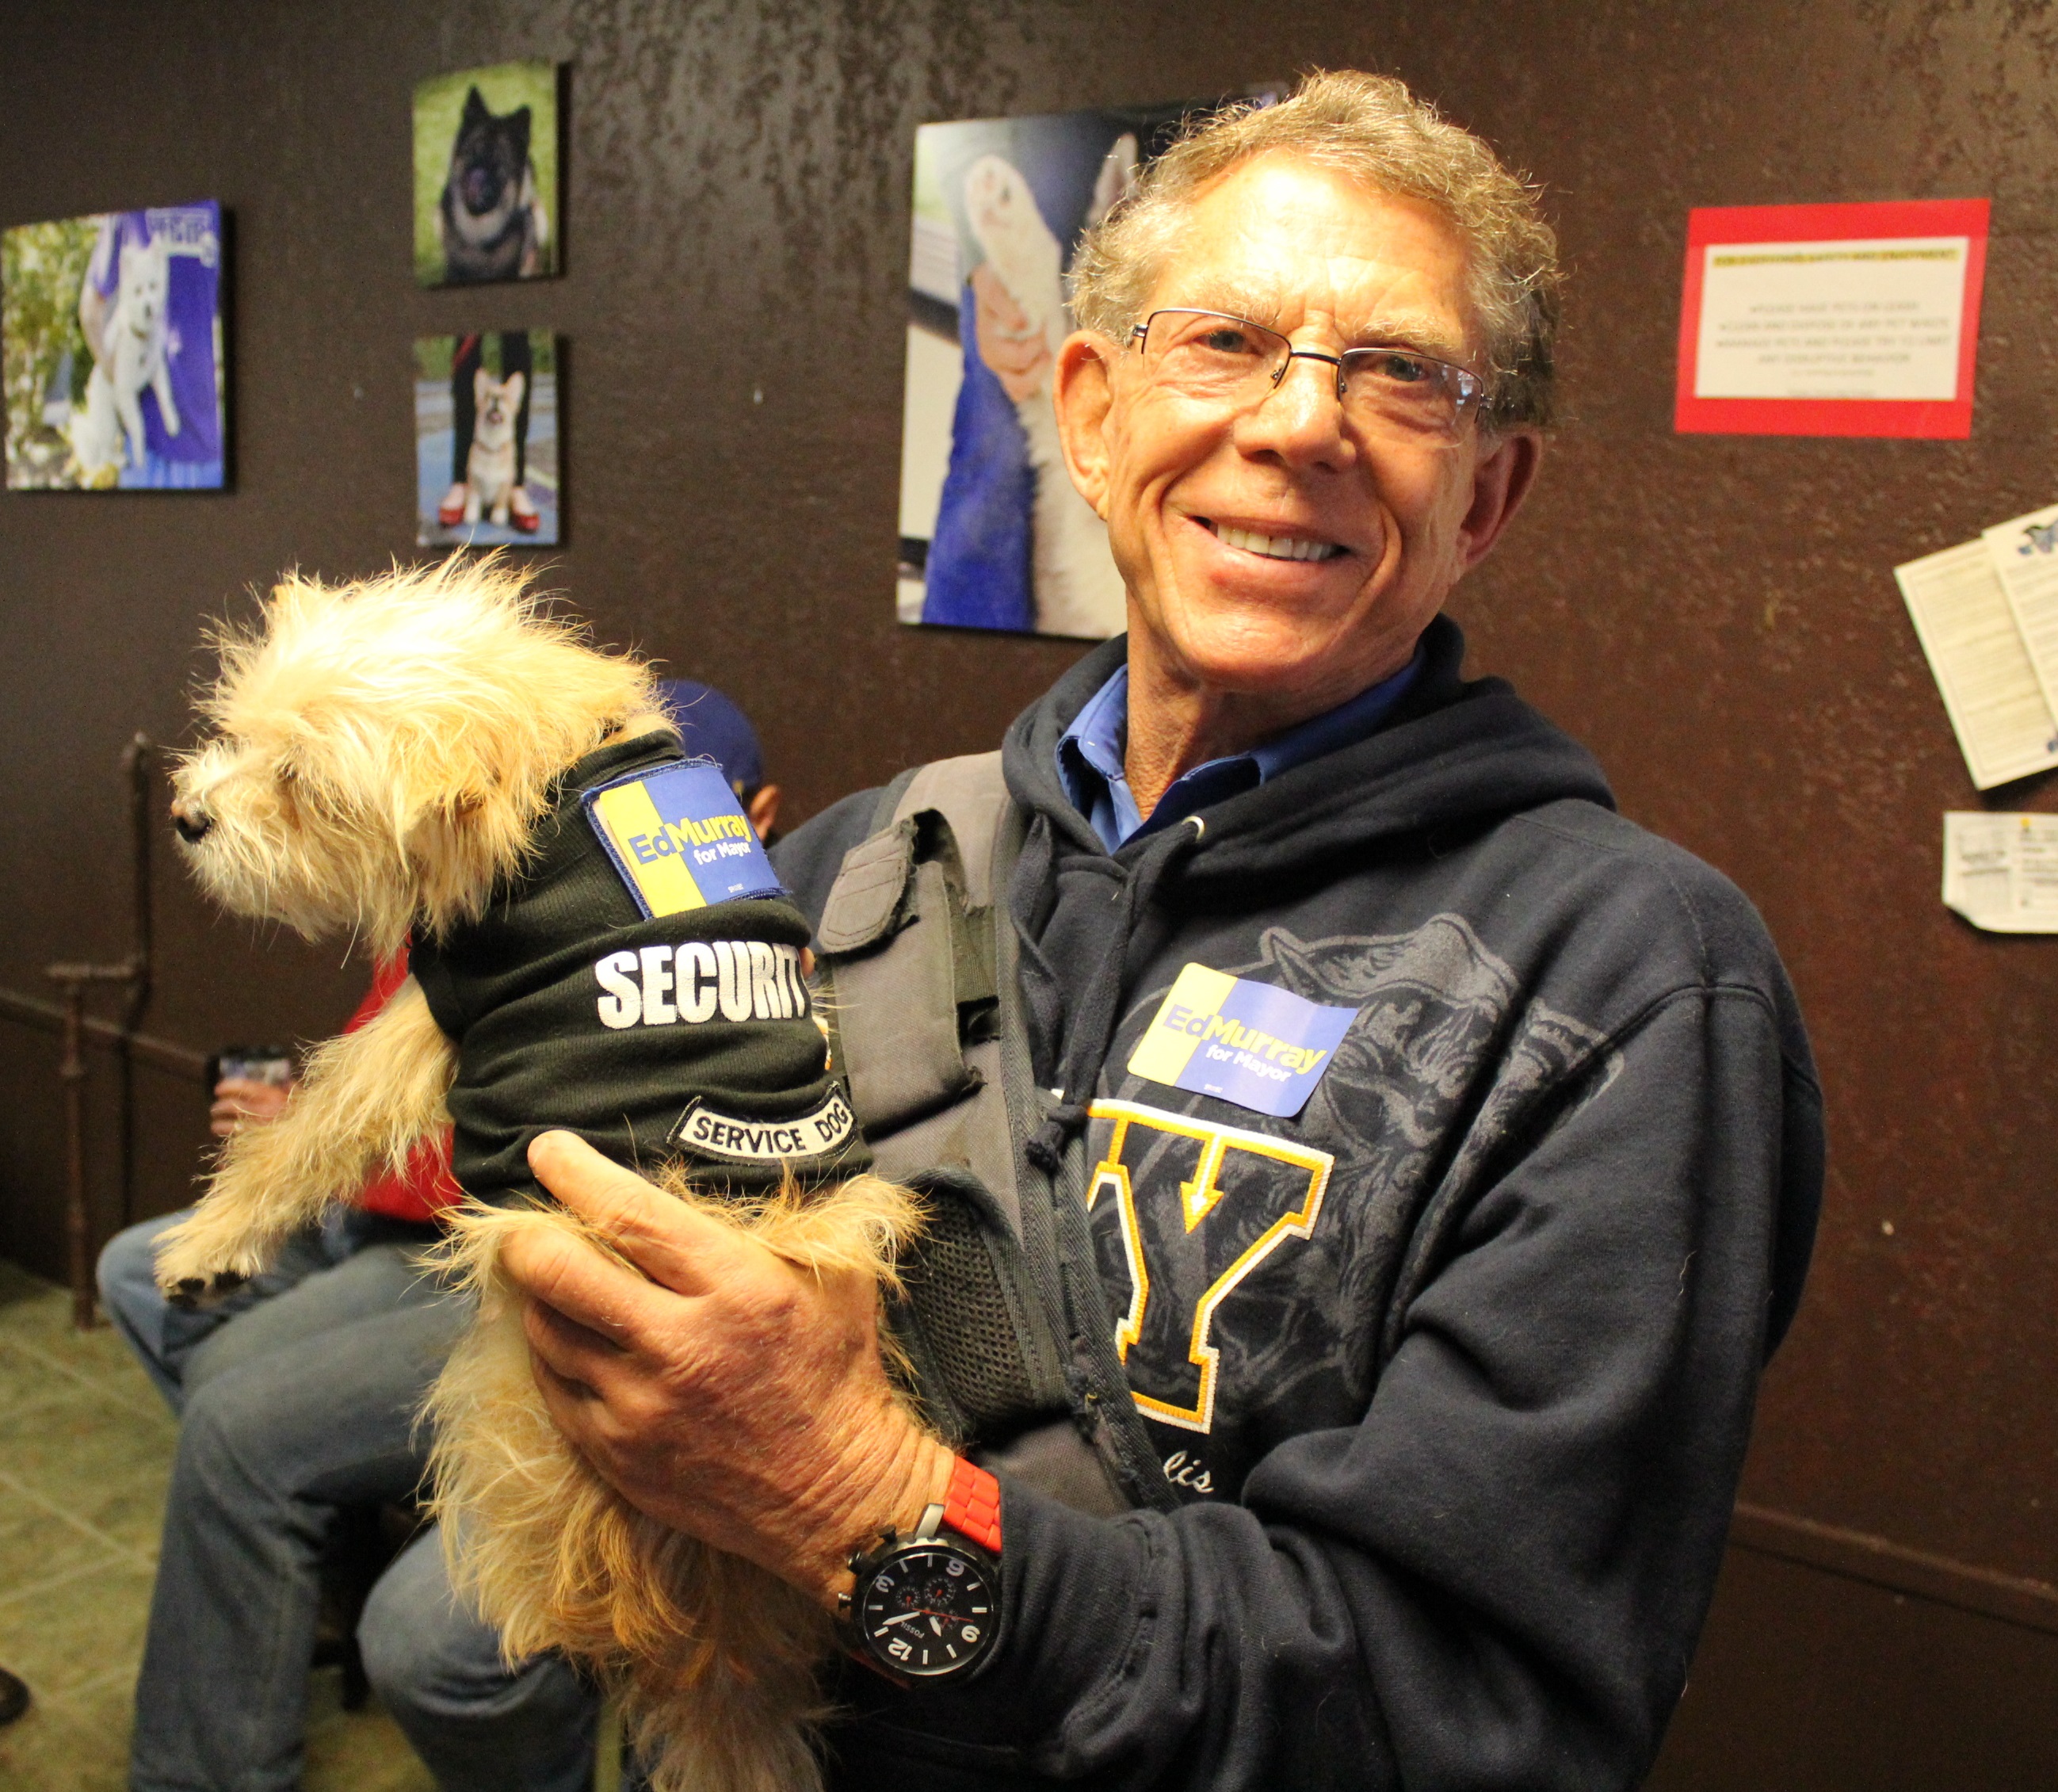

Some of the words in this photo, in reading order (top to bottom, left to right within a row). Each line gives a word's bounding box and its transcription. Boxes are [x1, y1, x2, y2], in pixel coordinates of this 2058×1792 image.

[693, 849, 717, 865] for
[716, 842, 750, 858] Mayor
[595, 941, 805, 1030] SECURIT
[1205, 1045, 1233, 1062] for
[1233, 1051, 1292, 1082] Mayor
[693, 1116, 807, 1153] SERVICE
[814, 1102, 849, 1143] DOG
[888, 1637, 913, 1661] 12
